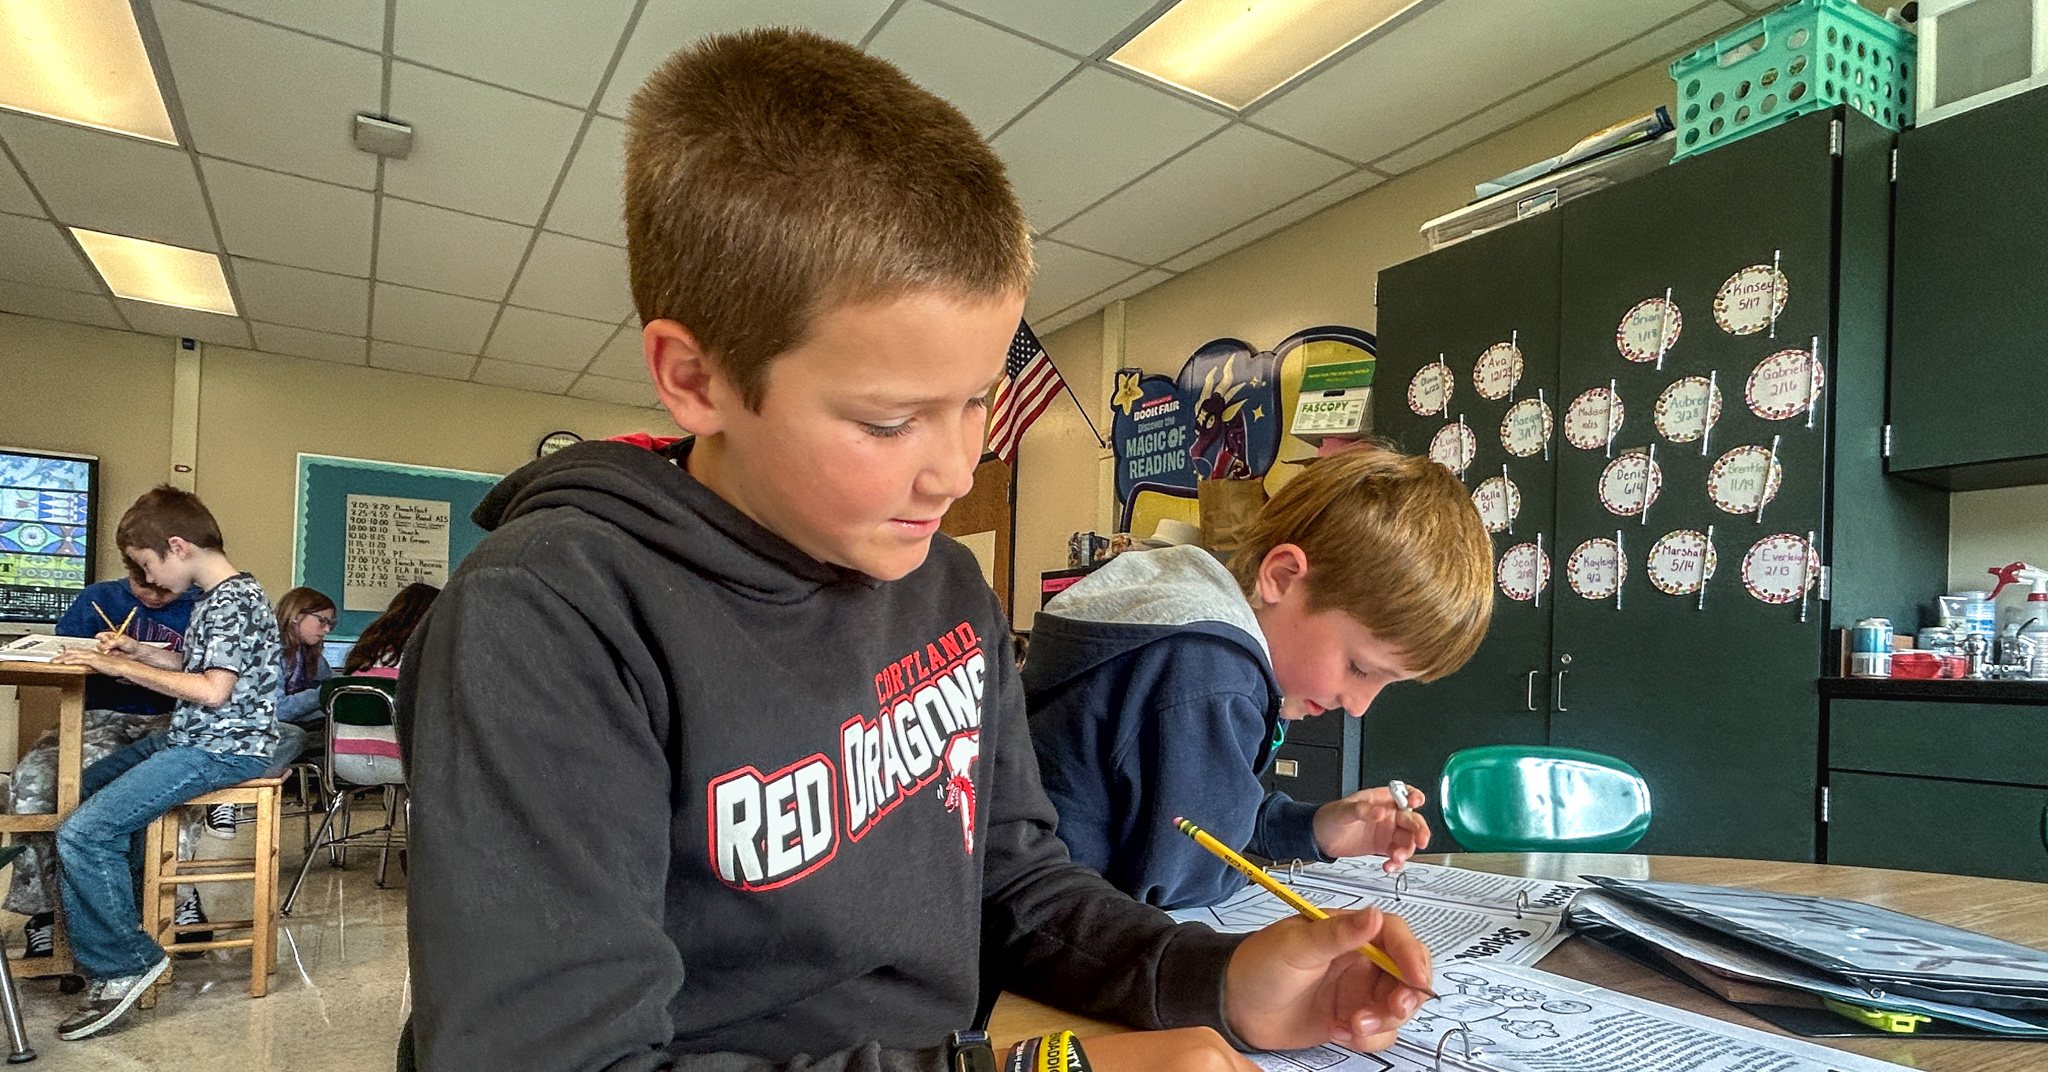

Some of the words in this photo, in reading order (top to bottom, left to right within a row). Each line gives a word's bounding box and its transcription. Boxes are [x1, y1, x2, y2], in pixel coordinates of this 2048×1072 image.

[1734, 281, 1774, 297] Kinsey
[1738, 297, 1760, 311] 5/17
[1632, 312, 1660, 327] Brian
[1488, 357, 1507, 368] Ava
[1770, 380, 1797, 396] 2/16
[1133, 406, 1158, 422] BOOK
[1158, 400, 1180, 414] FAIR
[1302, 401, 1348, 412] FASCOPY
[1578, 407, 1609, 416] Madison
[1126, 430, 1166, 458] MAGIC
[1168, 425, 1186, 448] OF
[1129, 449, 1185, 480] READING
[1616, 468, 1648, 481] Denis
[1624, 482, 1643, 494] 6/4
[1480, 491, 1500, 502] Bella
[1662, 545, 1706, 556] Marshall
[1670, 560, 1694, 572] 5/14
[875, 622, 978, 704] CORTLAND
[713, 758, 836, 884] RED
